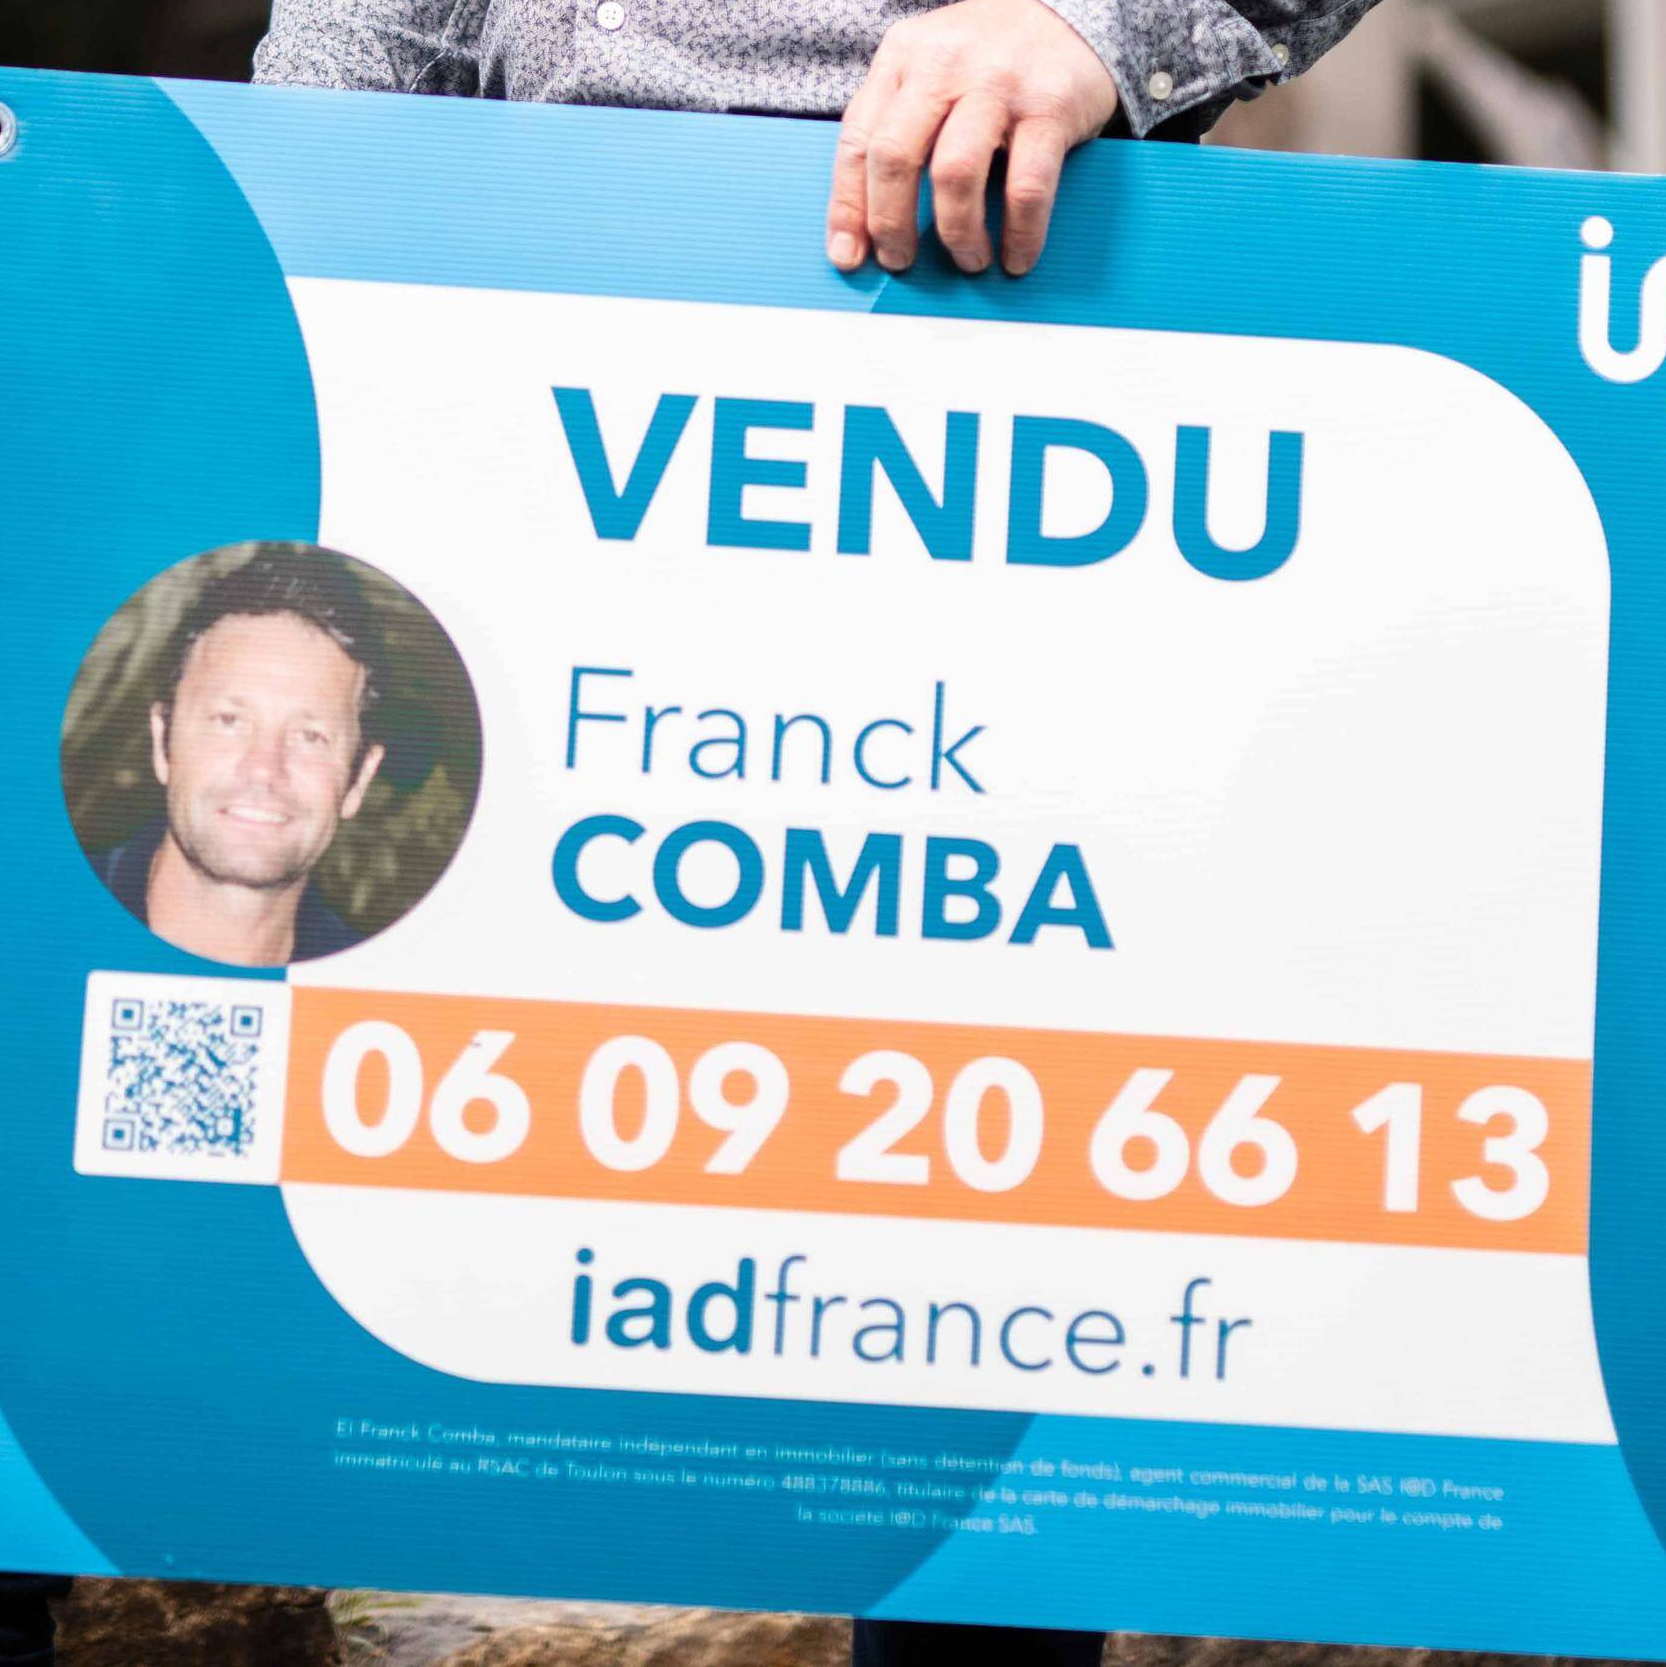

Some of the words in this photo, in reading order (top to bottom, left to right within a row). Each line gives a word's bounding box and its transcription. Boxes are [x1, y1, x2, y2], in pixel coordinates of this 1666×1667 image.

[551, 386, 1306, 582] VENDU
[565, 665, 986, 795] Franck
[550, 814, 1116, 952] COMBA
[321, 1020, 531, 1163] 06
[578, 1035, 790, 1174] 09
[836, 1050, 1044, 1193] 20
[1089, 1068, 1298, 1207] 66
[1352, 1082, 1550, 1221] 13
[569, 1246, 1253, 1381] iadfrance.fr
[360, 1421, 420, 1440] Franck
[508, 1431, 613, 1450] mandataire
[744, 1446, 768, 1458] en
[775, 1443, 873, 1464] immobilier
[1029, 1458, 1055, 1478] de
[1129, 1468, 1184, 1486] agent
[1189, 1468, 1297, 1490] commercial
[1304, 1473, 1328, 1492] de
[1334, 1475, 1350, 1493] la
[1356, 1476, 1394, 1495] SAS
[1442, 1479, 1505, 1502] France
[449, 1460, 470, 1473] au
[536, 1460, 558, 1476] de
[566, 1459, 628, 1480] Toulon
[634, 1470, 675, 1484] sous
[682, 1467, 698, 1484] le
[897, 1480, 966, 1499] titulaire
[1001, 1487, 1018, 1506] la
[1021, 1489, 1069, 1507] carte
[1073, 1491, 1098, 1509] de
[1225, 1498, 1325, 1520] immobilier
[1330, 1506, 1374, 1526] pour
[1380, 1506, 1397, 1526] le
[1402, 1510, 1473, 1532] compte
[1478, 1512, 1504, 1532] de
[797, 1502, 814, 1521] la
